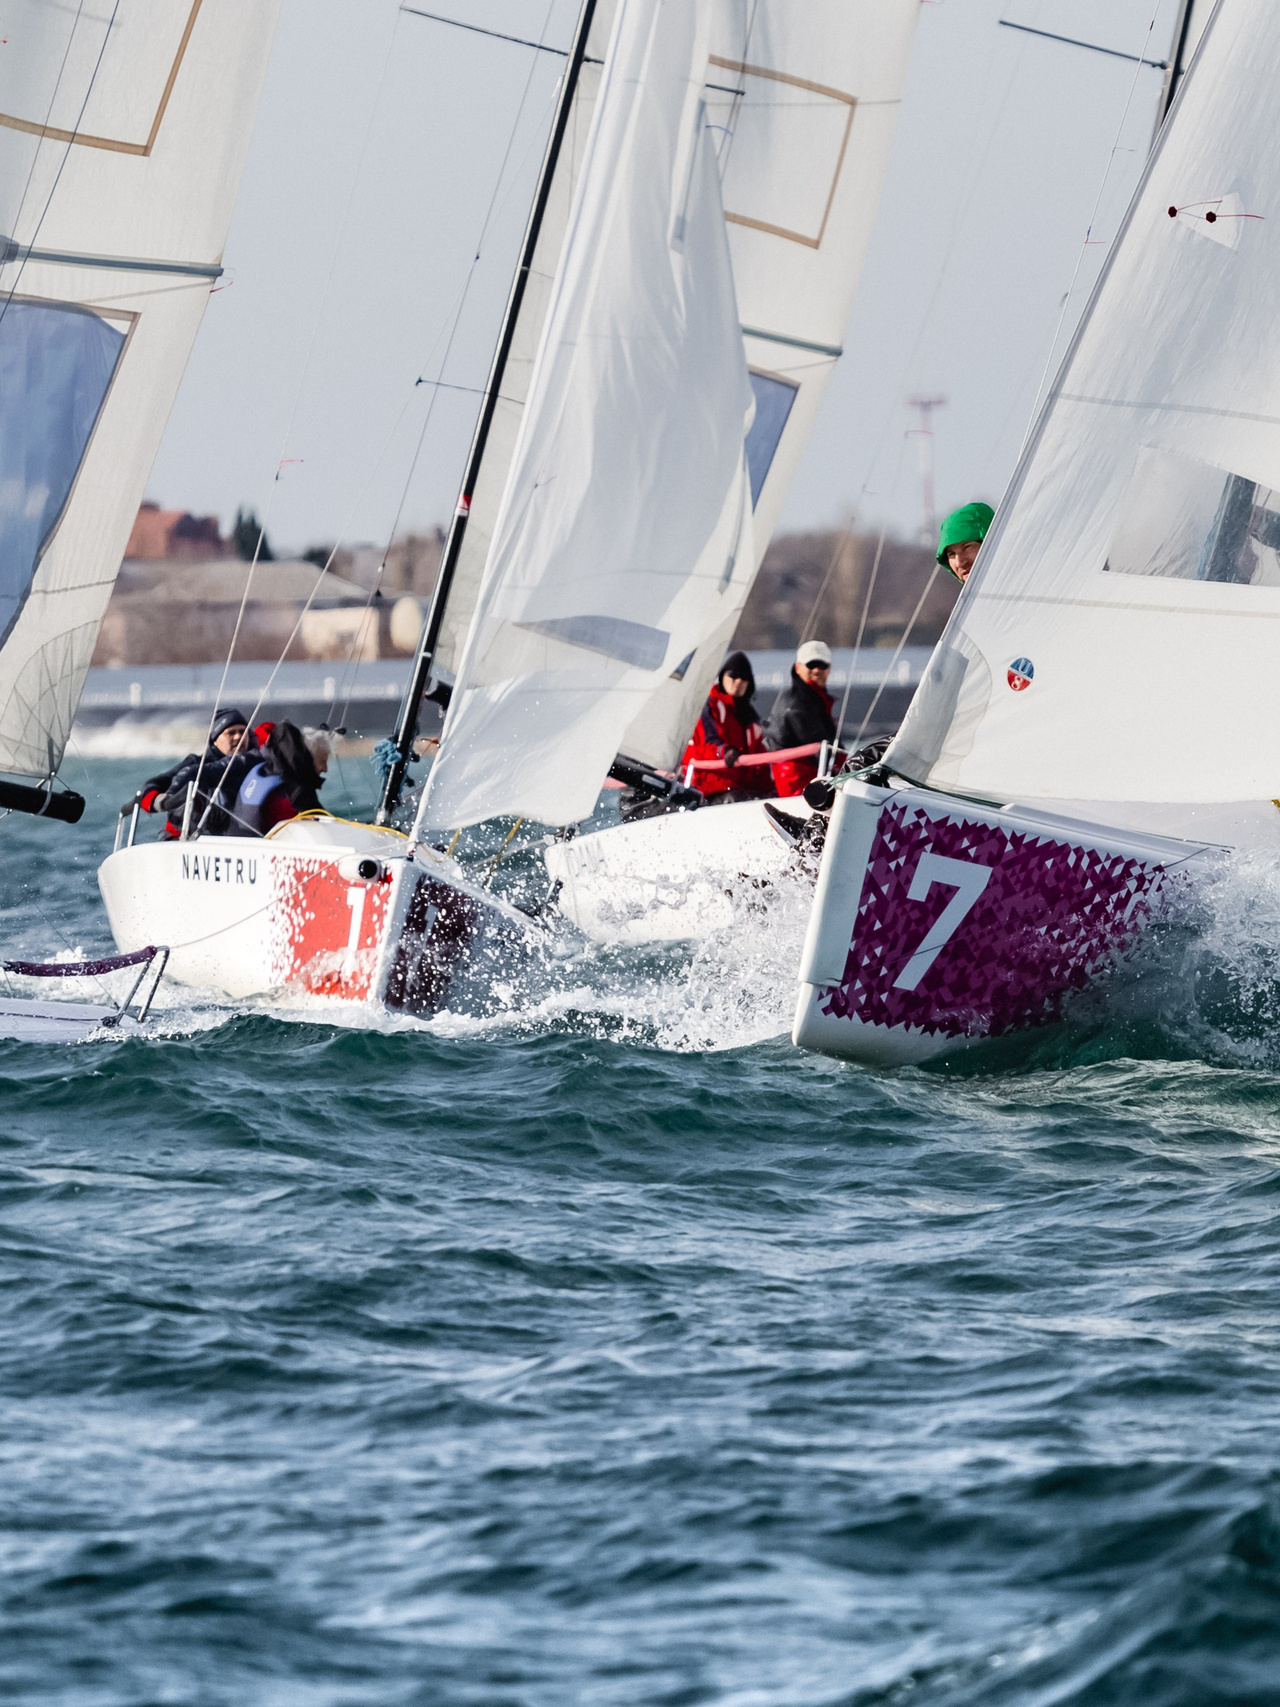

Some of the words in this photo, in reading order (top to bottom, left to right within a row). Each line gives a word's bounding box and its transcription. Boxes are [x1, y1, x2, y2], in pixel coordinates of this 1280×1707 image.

[182, 853, 257, 885] NAVETRU
[342, 886, 366, 980] 1
[893, 851, 993, 991] 7
